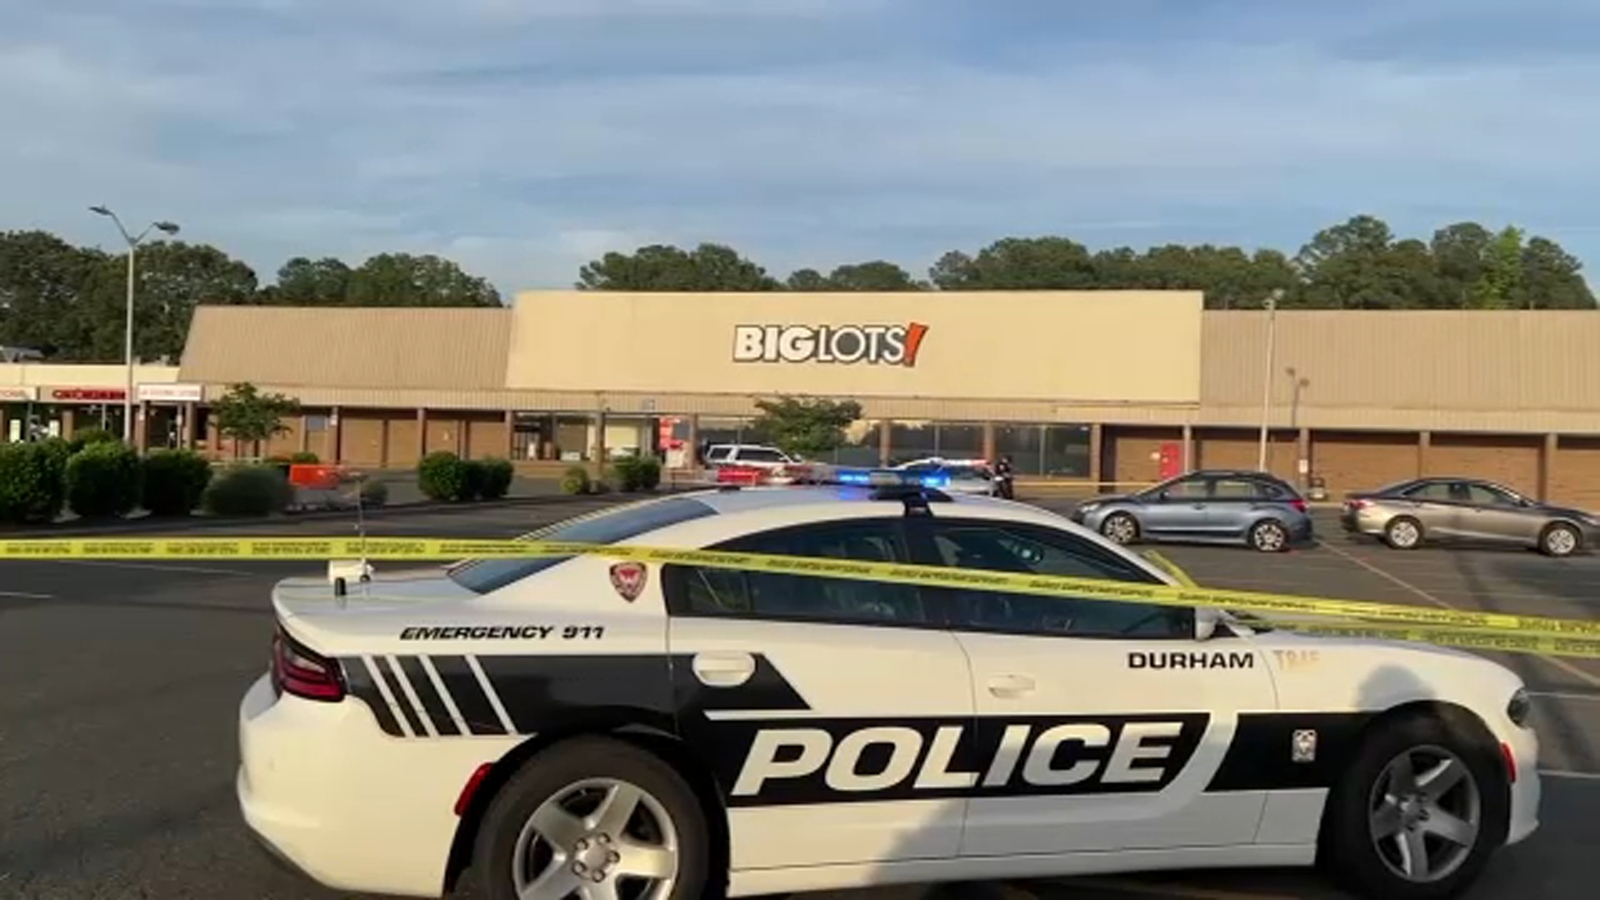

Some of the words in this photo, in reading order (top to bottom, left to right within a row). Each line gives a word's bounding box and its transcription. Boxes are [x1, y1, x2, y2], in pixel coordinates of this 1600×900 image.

[399, 625, 554, 641] EMERGENCY
[562, 626, 605, 640] 911
[1127, 651, 1254, 669] DURHAM
[730, 721, 1184, 797] POLICE
